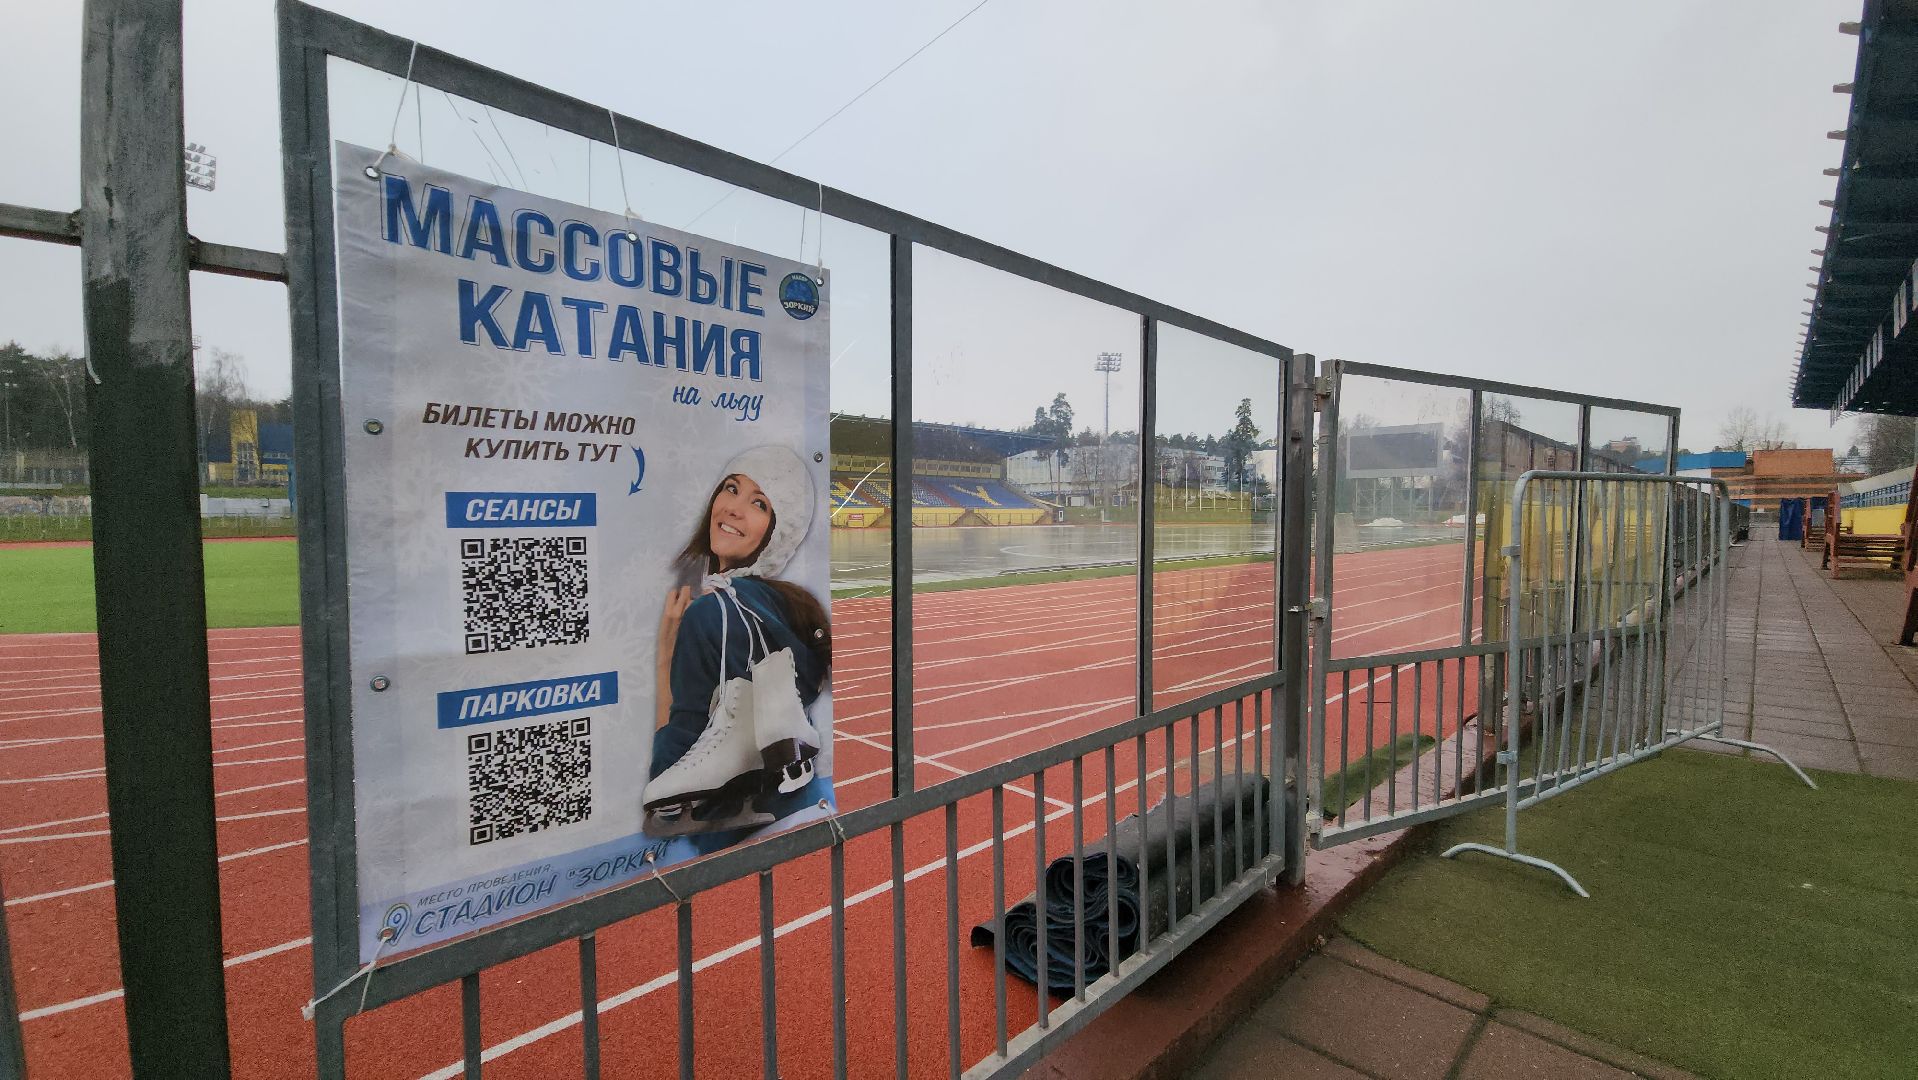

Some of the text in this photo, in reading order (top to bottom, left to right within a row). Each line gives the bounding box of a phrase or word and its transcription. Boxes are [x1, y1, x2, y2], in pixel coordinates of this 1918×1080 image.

[380, 172, 767, 317] МАССОВЫЕ
[458, 278, 763, 382] КАТАНИЯ
[422, 402, 636, 436] БИЛЕТЫ МОЖНО
[672, 385, 764, 421] на льду
[464, 438, 622, 463] КУПИТЬ ТУТ
[465, 499, 582, 522] СЕАНСЫ
[458, 679, 601, 720] ПАРКОВКА
[415, 874, 558, 935] СТАДИОН
[416, 887, 463, 908] МЕСТО
